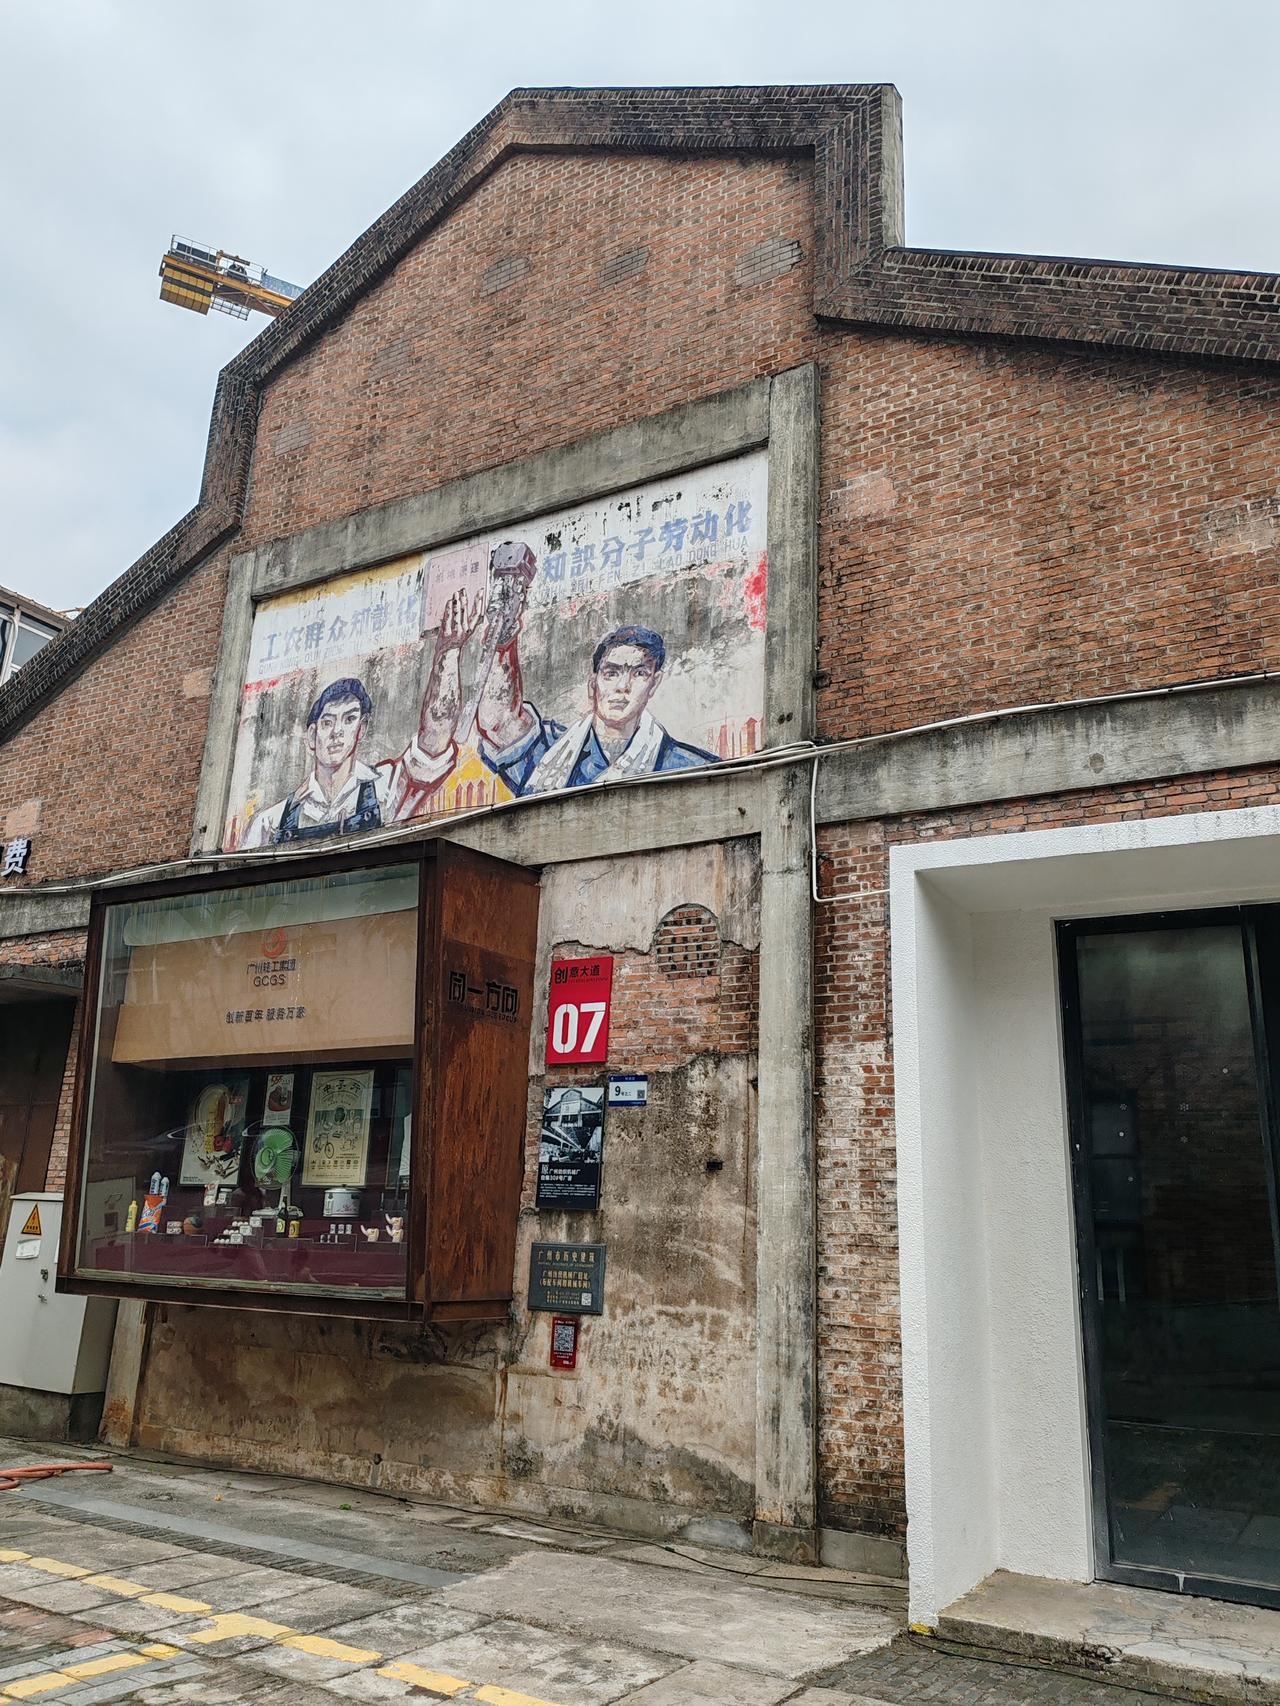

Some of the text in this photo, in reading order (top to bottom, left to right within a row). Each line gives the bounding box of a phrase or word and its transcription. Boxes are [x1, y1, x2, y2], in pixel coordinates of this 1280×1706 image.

[724, 535, 749, 551] HUA
[246, 959, 296, 975] 广州轻工集团
[555, 964, 601, 984] 创意大道
[253, 974, 286, 987] GCGS
[448, 971, 519, 1015] 同一方向
[226, 1009, 264, 1024] 创新百年
[552, 1002, 606, 1053] 07
[537, 1249, 596, 1263] 广州市历史建筑
